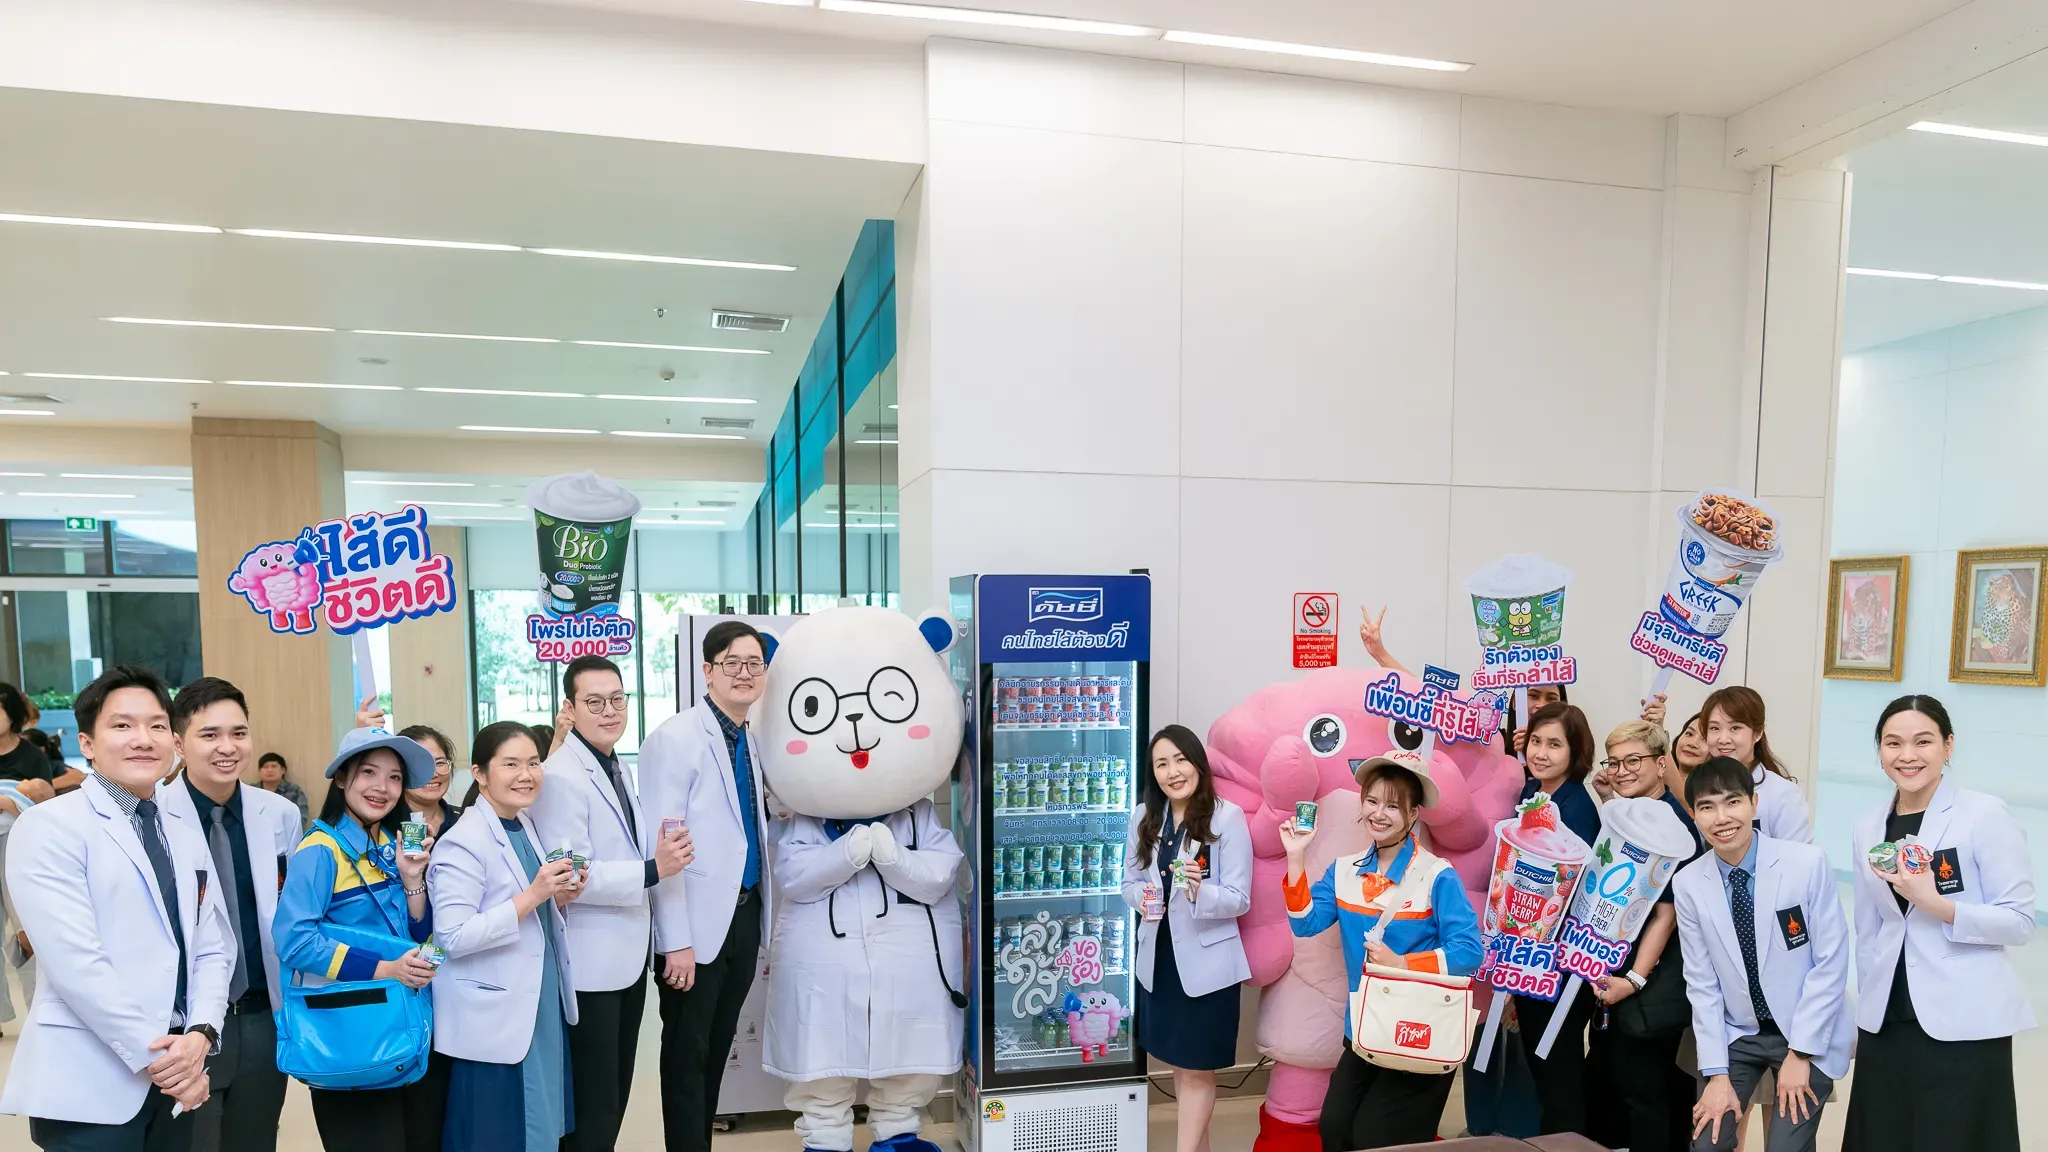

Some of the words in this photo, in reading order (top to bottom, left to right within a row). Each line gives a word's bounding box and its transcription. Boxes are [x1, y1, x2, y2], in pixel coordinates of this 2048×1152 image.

[319, 509, 420, 576] ไส้ดี
[563, 561, 578, 569] Duo
[580, 562, 602, 570] Probiotic
[324, 559, 445, 623] ชีวิตดี
[1679, 581, 1722, 613] GREEK
[530, 618, 630, 639] โพรไบโอติก
[1002, 621, 1130, 649] คนไทยไส้ต้องดี
[1642, 615, 1723, 663] มีจุลินทรีย์ดี
[540, 640, 607, 660] 20,000
[1485, 645, 1558, 664] รักตัวเอง
[1635, 633, 1716, 680] ช่วยดูแลลำไส้
[1473, 659, 1573, 687] เริ่มที่รักลำไส้
[1622, 847, 1648, 862] DUTCHIE
[1513, 879, 1545, 896] Probiotic
[1515, 867, 1553, 883] DUTCHIE
[1510, 903, 1537, 922] BERRY
[1512, 890, 1541, 910] STRAW
[1595, 898, 1616, 922] HIGH
[1073, 941, 1098, 959] ขอ
[1504, 934, 1555, 970] ไส้ดี
[1562, 920, 1625, 966] ไฟเบอร์
[1071, 957, 1101, 985] ร้อง
[1493, 963, 1558, 996] ชีวิตดี
